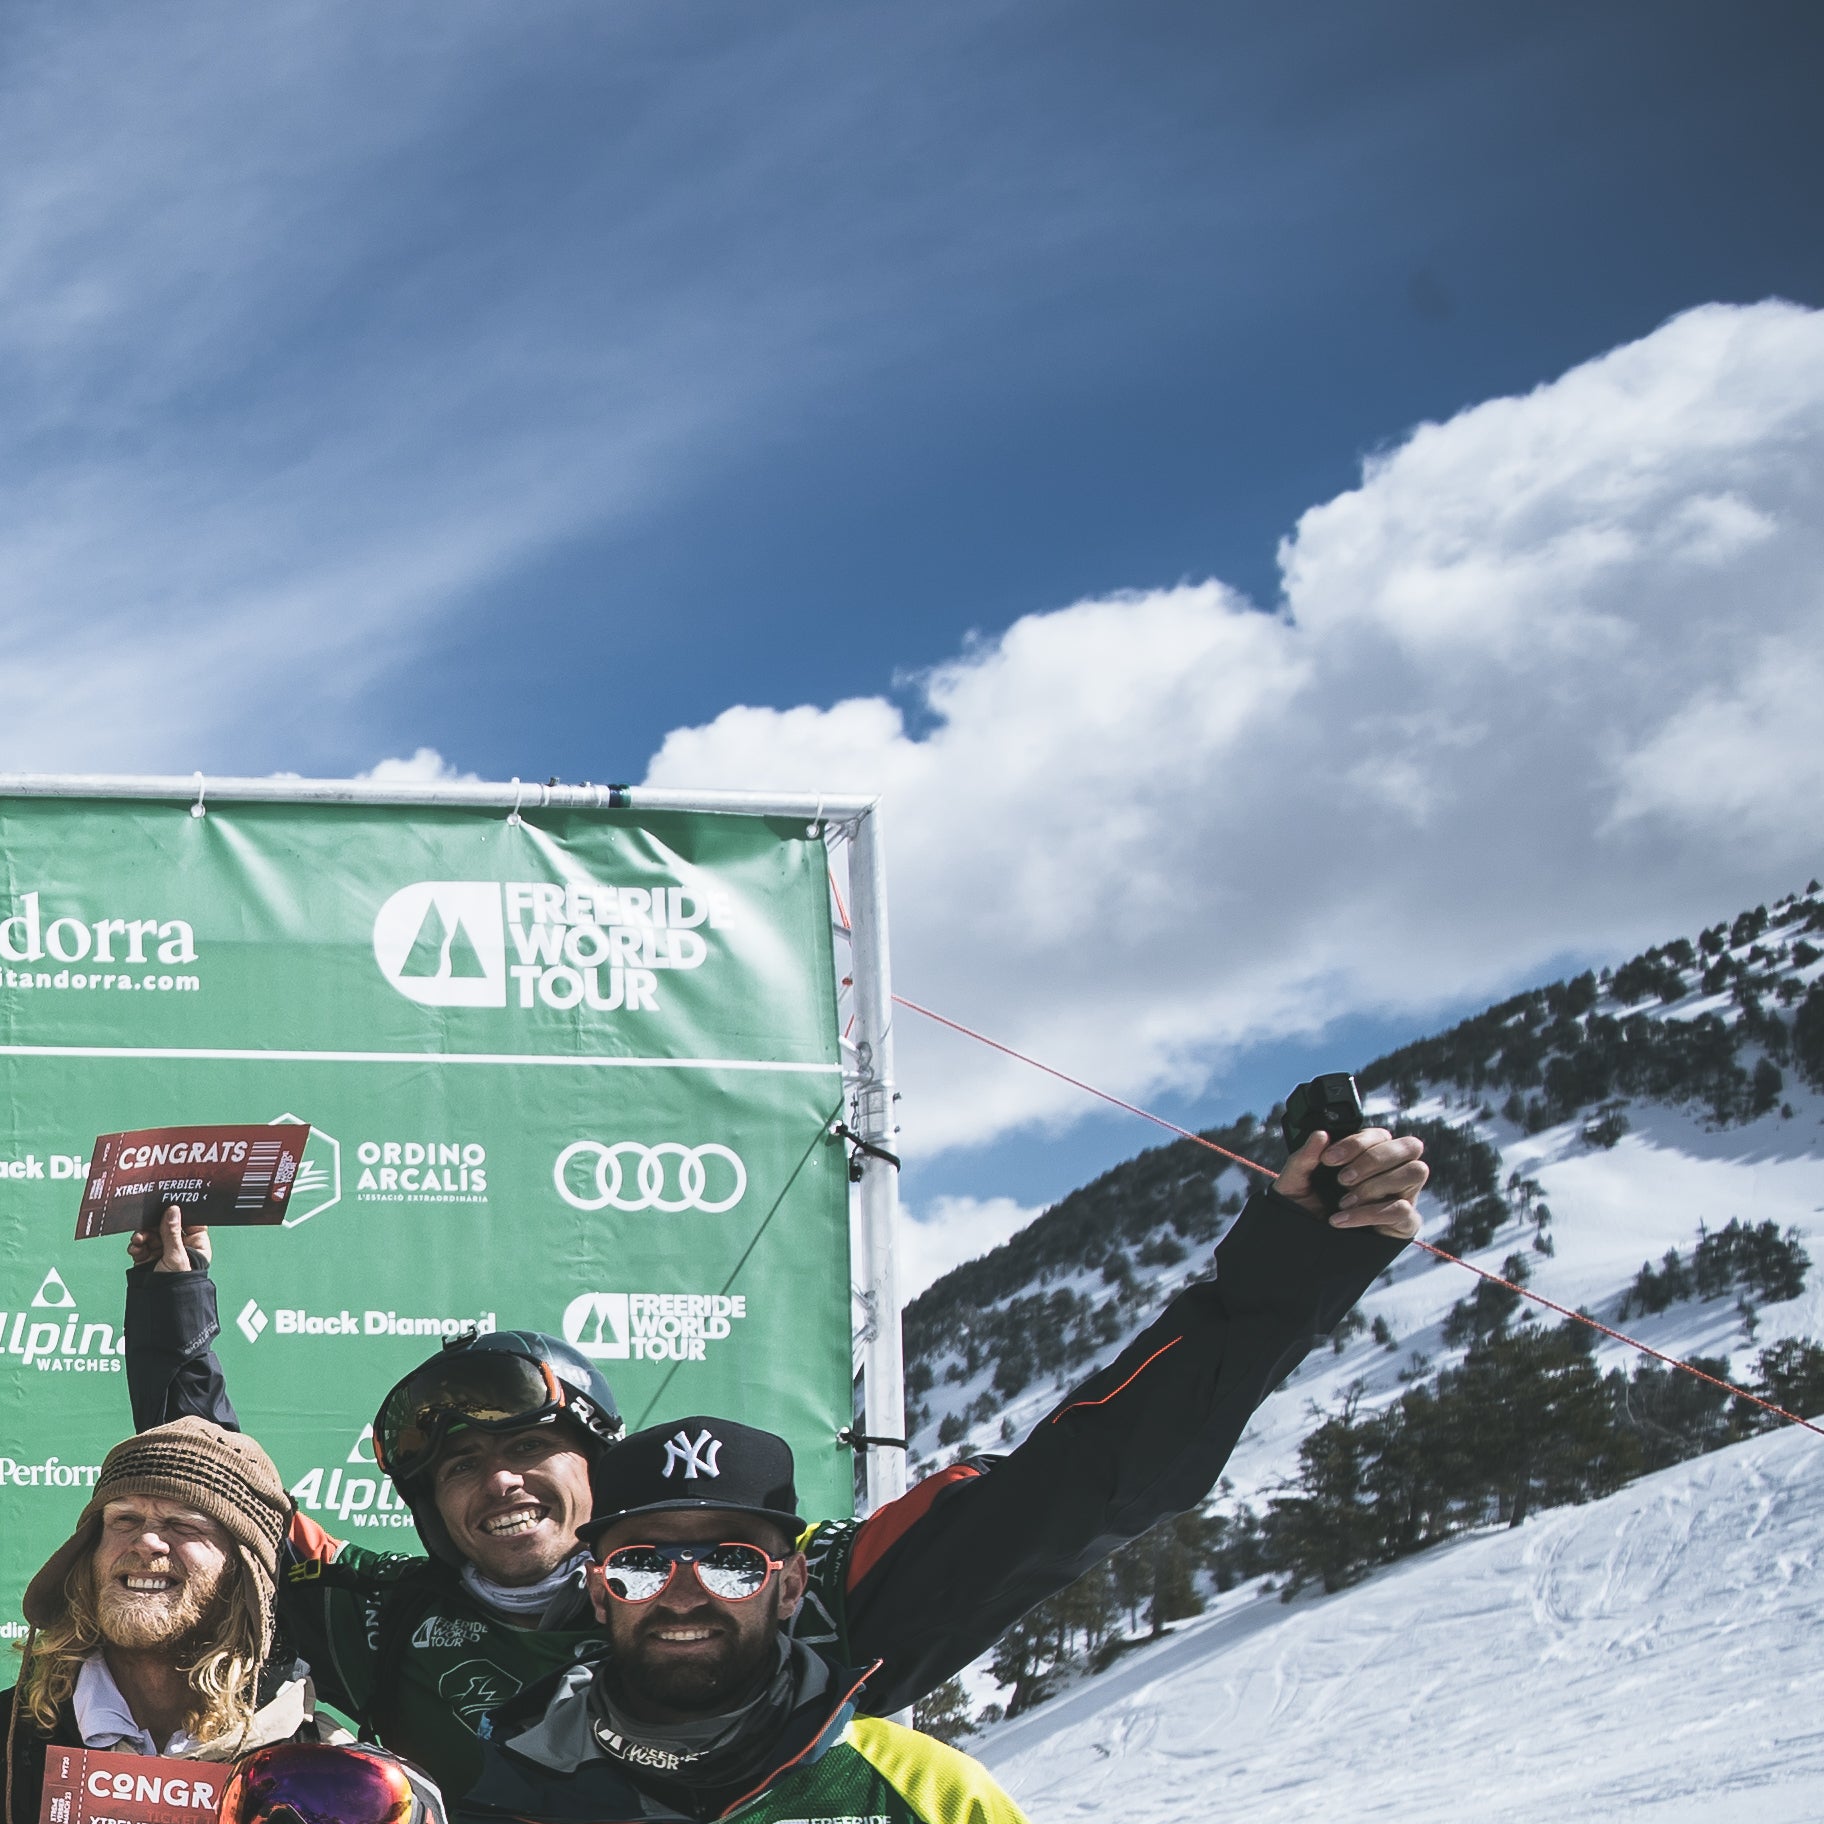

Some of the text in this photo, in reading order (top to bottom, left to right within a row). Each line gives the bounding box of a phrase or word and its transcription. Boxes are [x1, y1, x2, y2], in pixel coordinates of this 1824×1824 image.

[506, 883, 737, 931] FREERIDE
[508, 925, 708, 971] WORLD
[510, 966, 660, 1012] TOUR
[118, 1140, 249, 1171] CONGRATS
[358, 1141, 486, 1166] ORDINO
[114, 1179, 203, 1198] XTREME VERBIER
[357, 1162, 488, 1193] ARCALÍS
[162, 1192, 199, 1203] FWT20
[630, 1295, 746, 1318] FREERIDE
[274, 1309, 497, 1336] Black Diamond
[629, 1316, 731, 1339] WORLD
[629, 1338, 707, 1361] TOUR
[36, 1357, 122, 1372] WATCHES
[87, 1770, 216, 1810] CONGR
